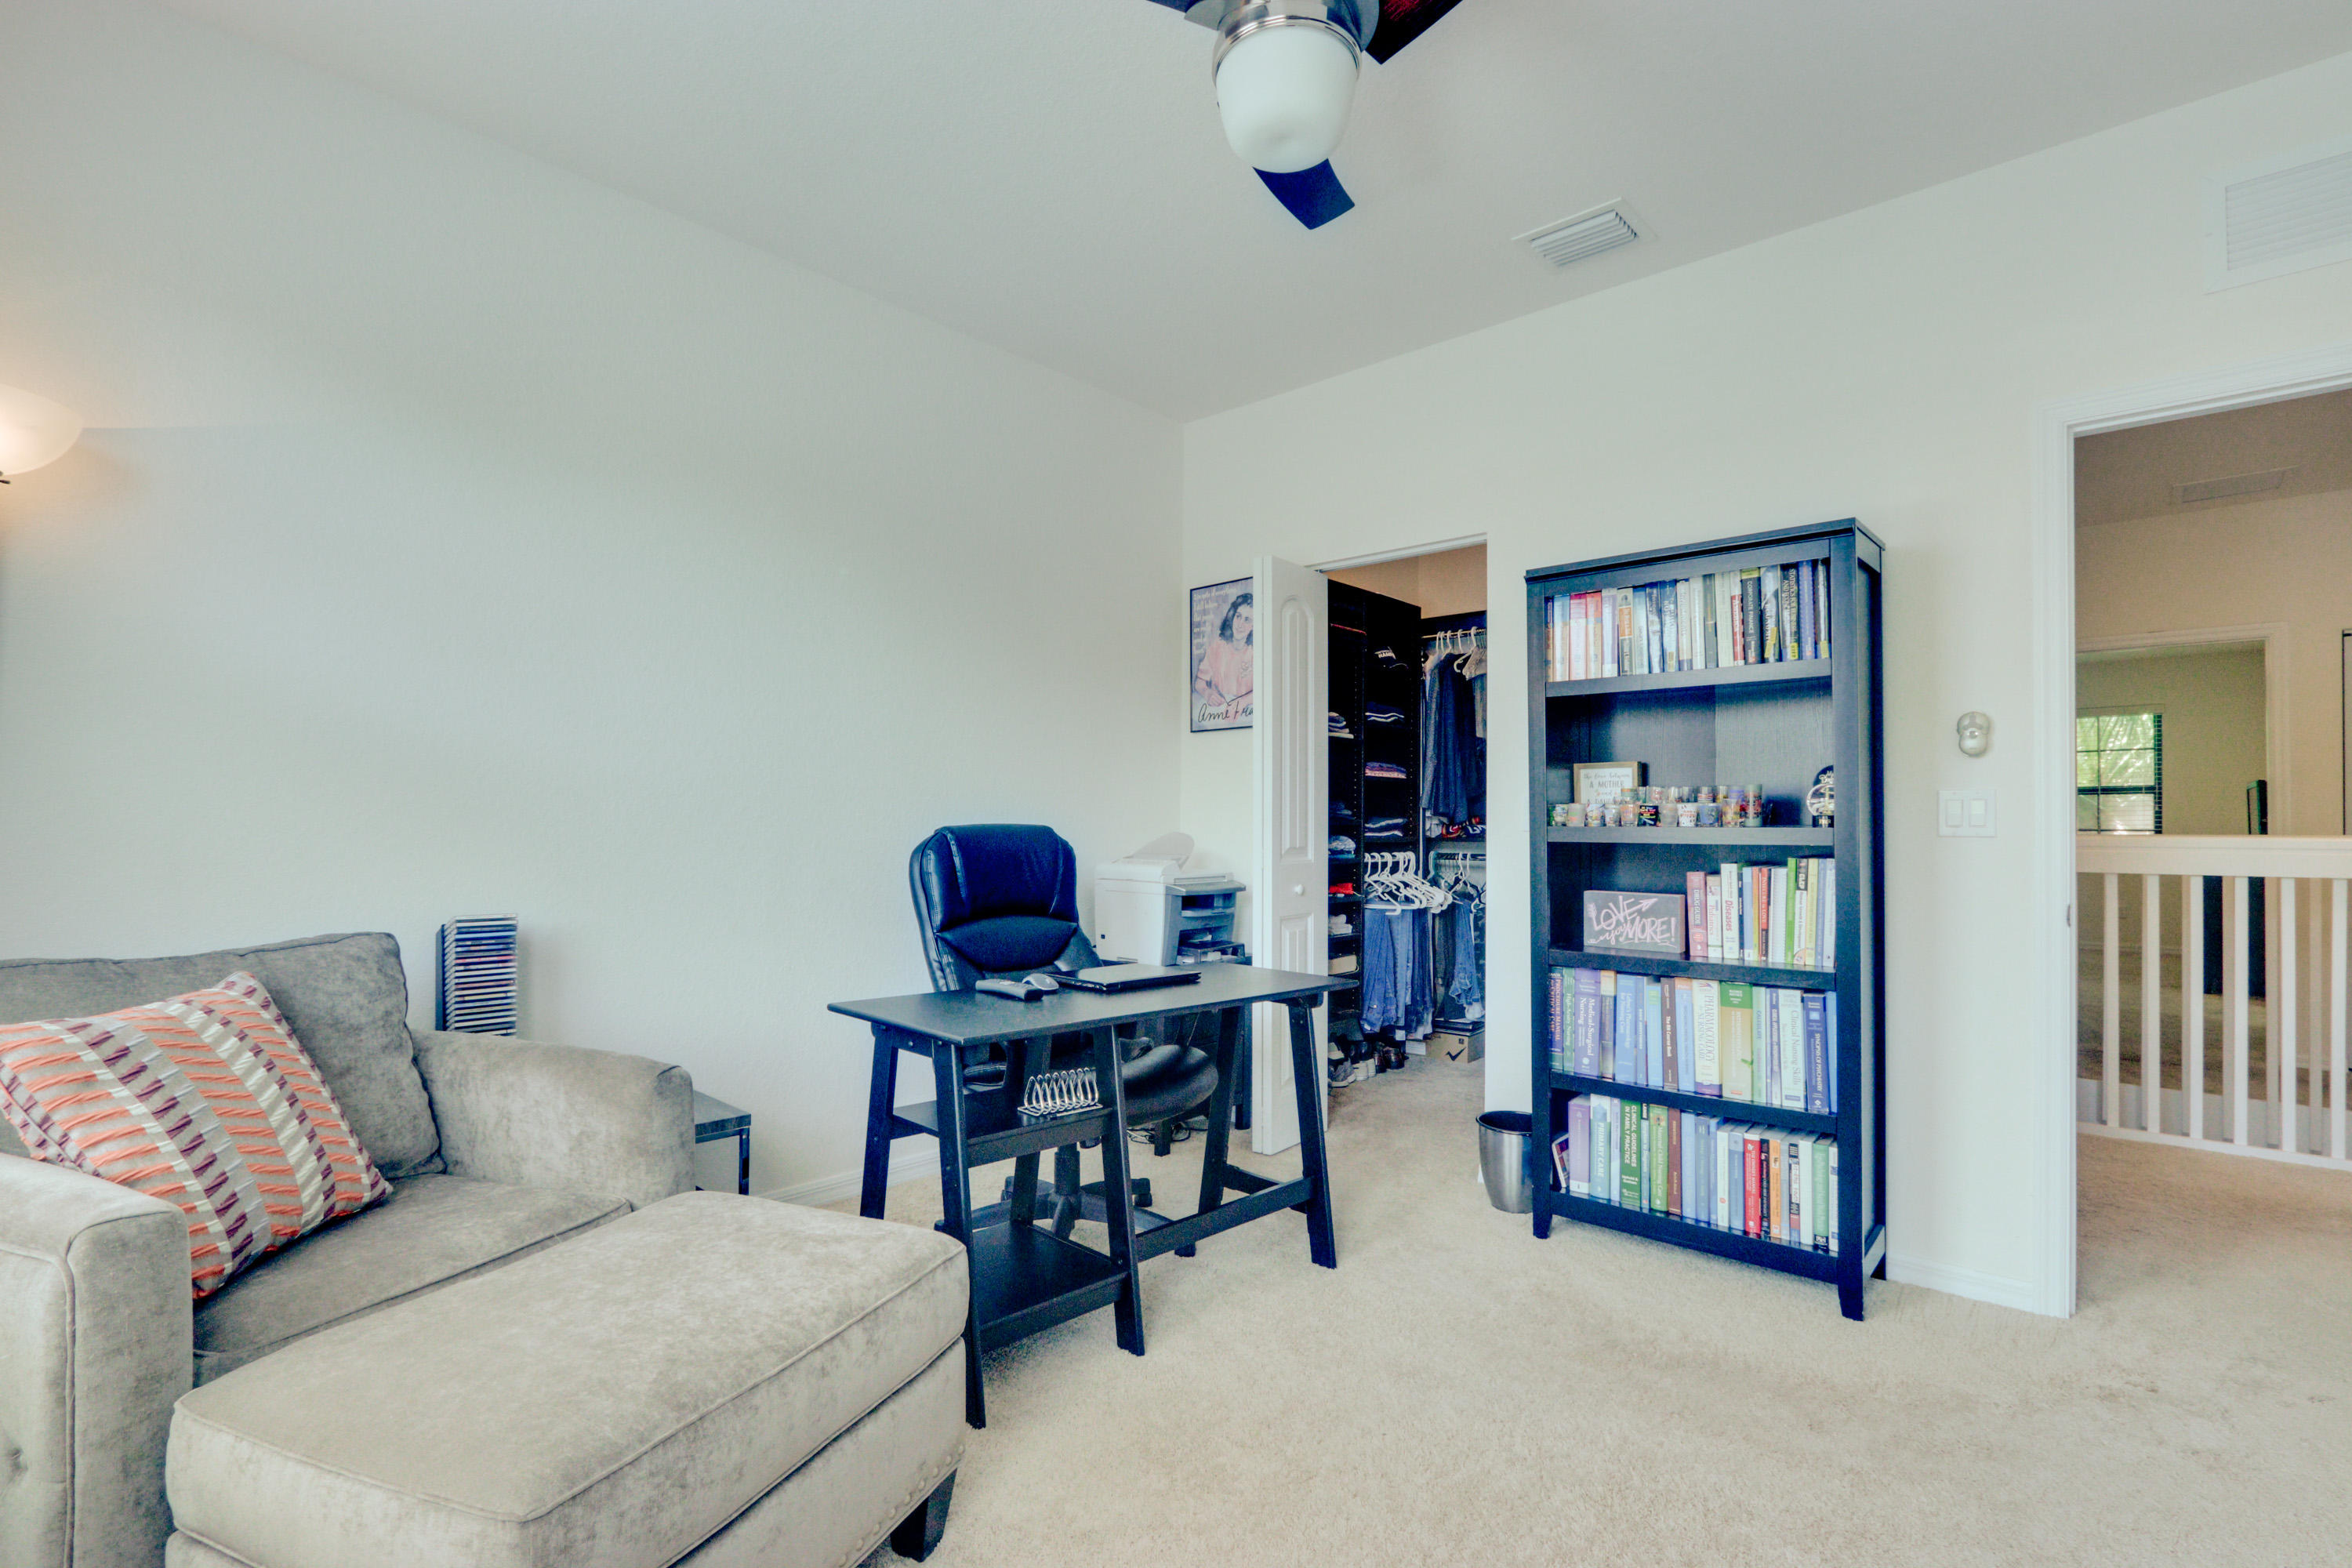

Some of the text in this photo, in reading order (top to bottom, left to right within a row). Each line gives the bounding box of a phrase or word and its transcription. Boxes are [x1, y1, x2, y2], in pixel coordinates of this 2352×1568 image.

[1197, 702, 1229, 723] Anne
[1588, 895, 1639, 931] LOVE
[1725, 900, 1733, 932] Diseases
[1620, 916, 1676, 943] MORE!
[1578, 997, 1587, 1024] Nursing
[1705, 994, 1715, 1062] PHARMACOLOGY
[1790, 1010, 1802, 1085] Clinical Nursing Skills
